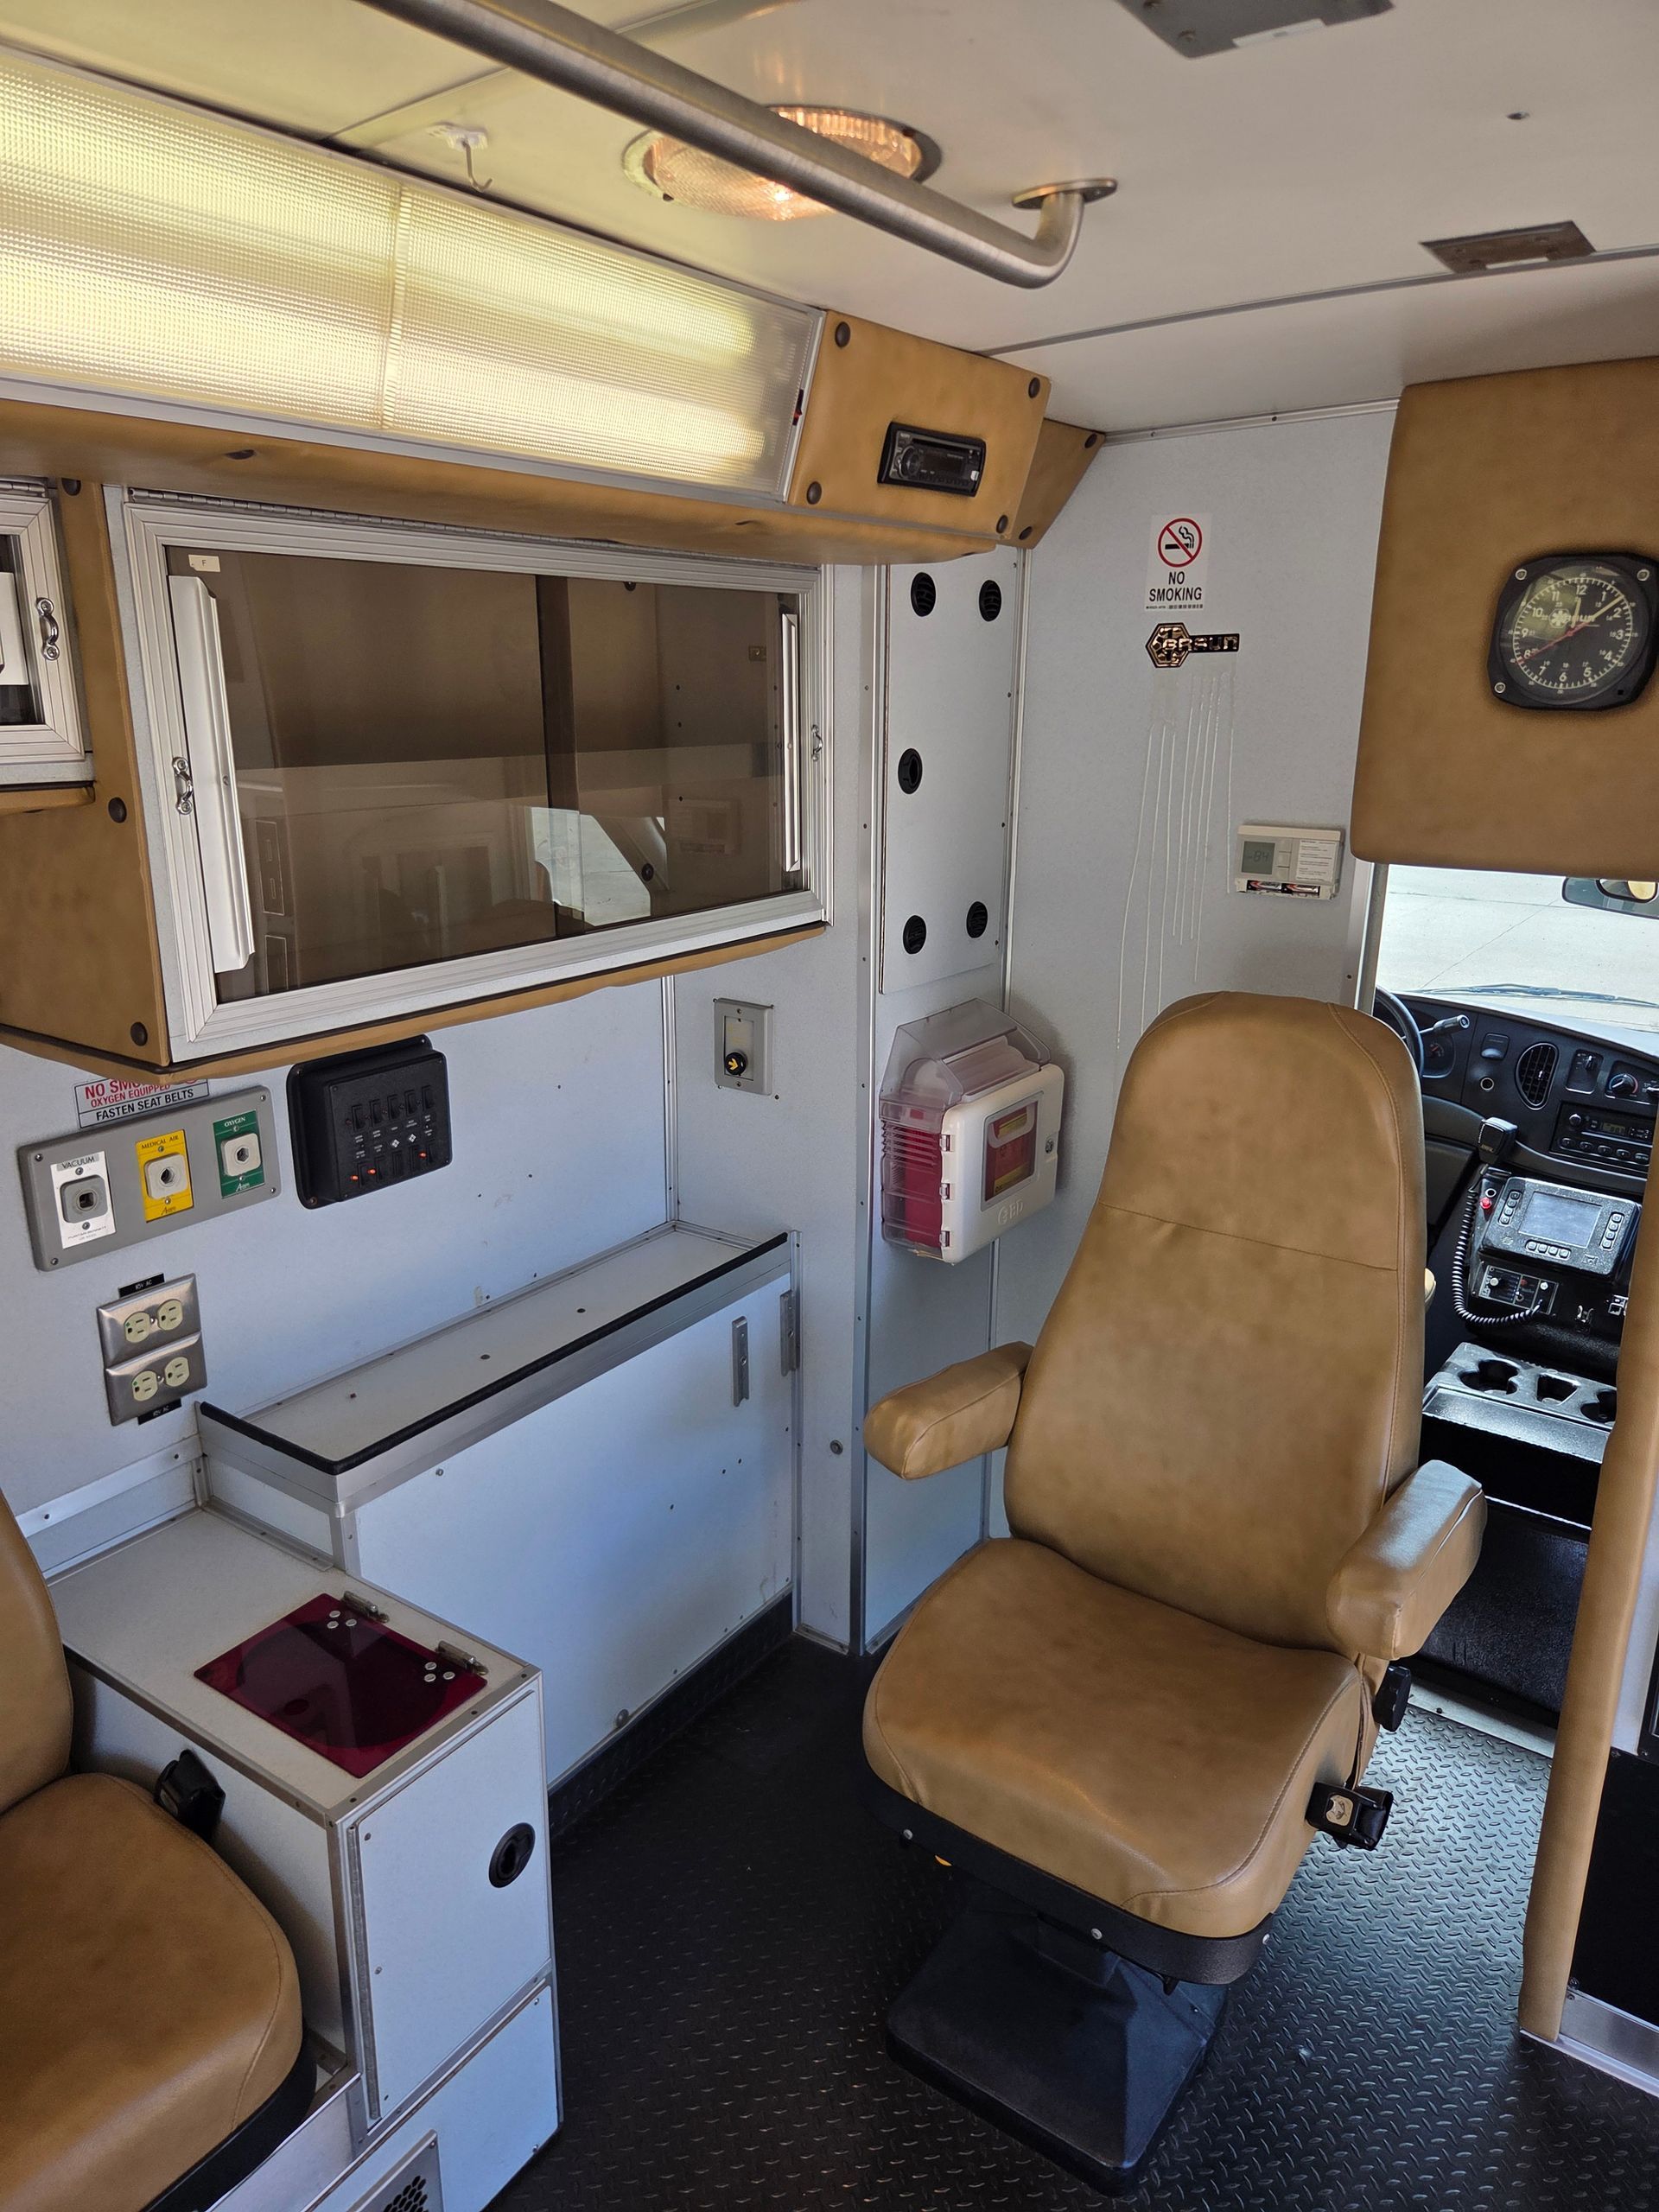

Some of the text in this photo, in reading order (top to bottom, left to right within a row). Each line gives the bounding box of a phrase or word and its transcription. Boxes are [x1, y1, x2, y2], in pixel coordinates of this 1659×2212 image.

[1168, 570, 1185, 585] NO
[1148, 587, 1203, 602] SMOKING
[1576, 584, 1588, 595] 12
[1601, 590, 1607, 602] 1
[1532, 607, 1543, 618] 10
[1612, 607, 1622, 618] 2
[1522, 627, 1529, 638] 9
[1615, 629, 1624, 640] 3
[1603, 650, 1612, 661] 4
[1539, 665, 1547, 676] 7
[1583, 666, 1592, 678] 5
[1558, 672, 1567, 682] 6
[85, 1083, 105, 1100] NO
[91, 1091, 126, 1108] OXYGEN
[96, 1088, 194, 1121] FASTEN SEAT BELTS
[224, 1116, 246, 1128] OXYGEN
[141, 1139, 167, 1150] MEDICAL
[61, 1155, 95, 1169] VACUUM
